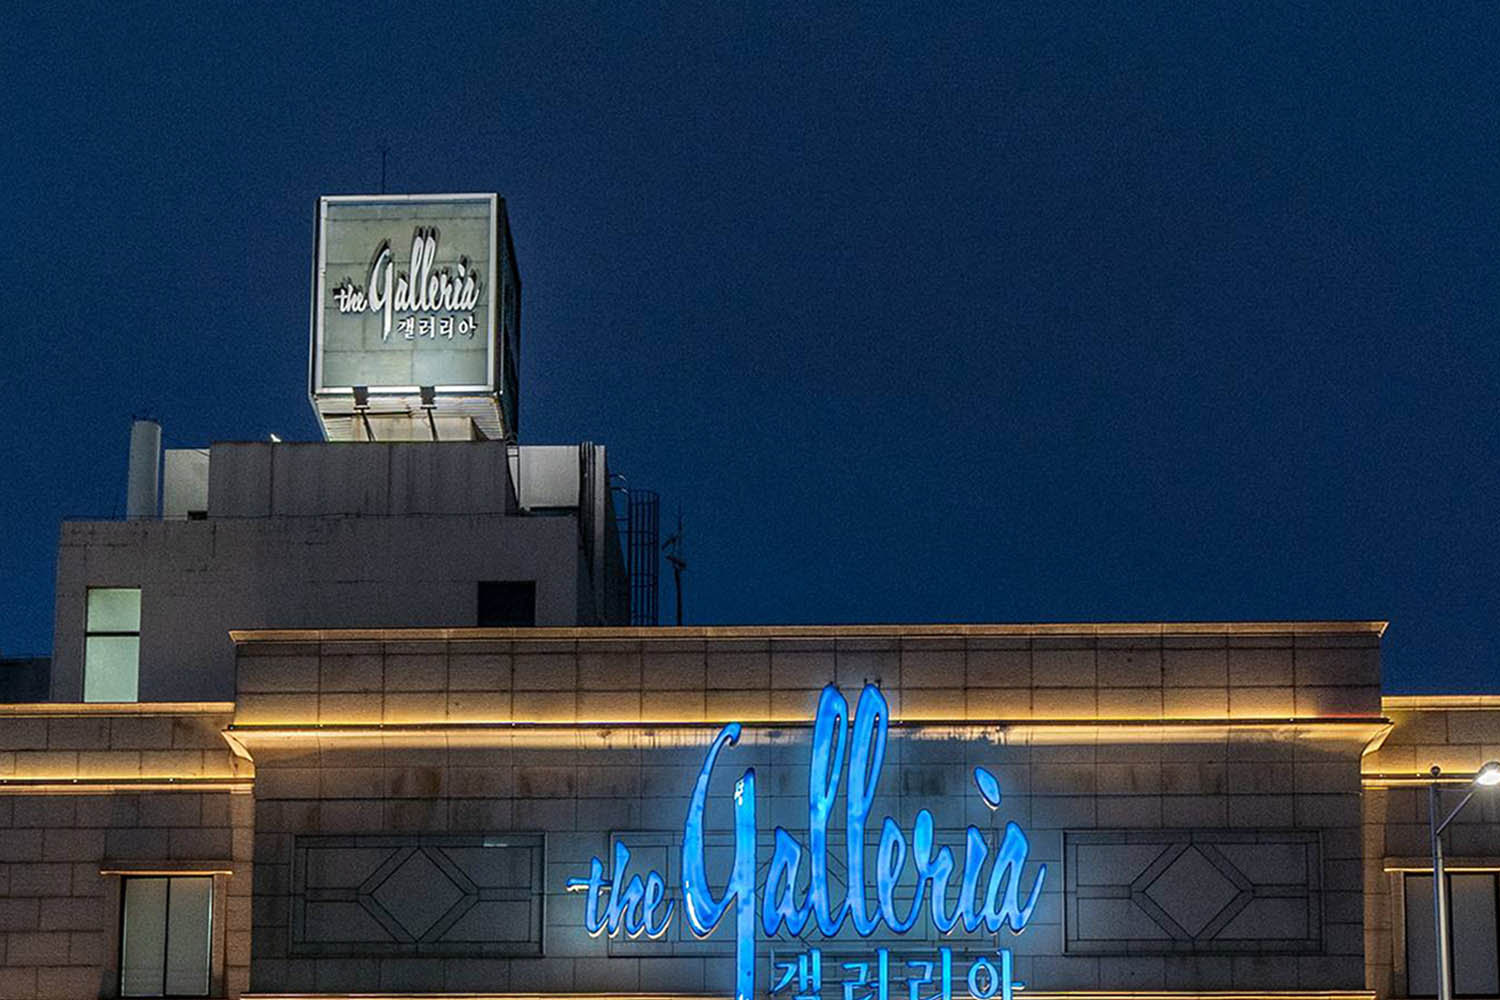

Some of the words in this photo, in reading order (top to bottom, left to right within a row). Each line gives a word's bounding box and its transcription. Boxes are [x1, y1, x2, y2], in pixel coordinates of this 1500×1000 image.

[333, 283, 367, 313] the
[368, 235, 480, 341] Galleria
[397, 316, 477, 340] 갤러리아
[566, 840, 675, 938] the
